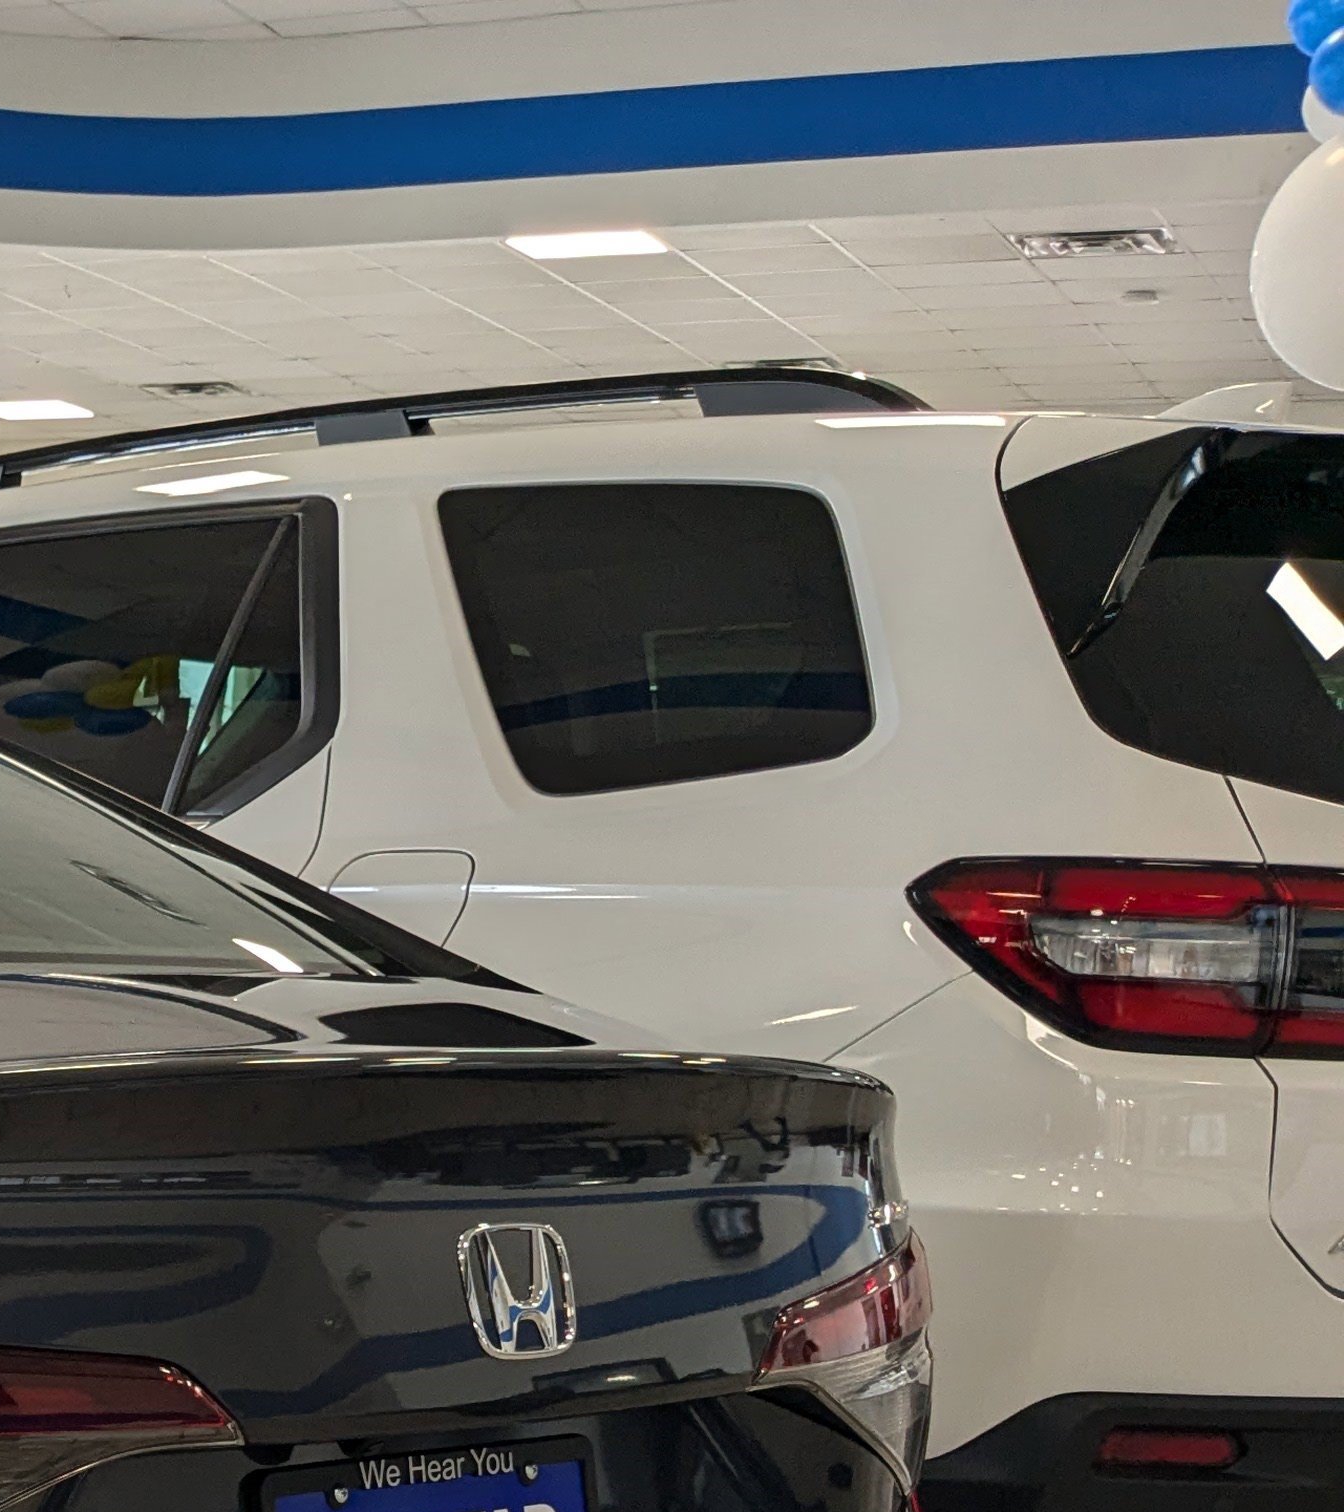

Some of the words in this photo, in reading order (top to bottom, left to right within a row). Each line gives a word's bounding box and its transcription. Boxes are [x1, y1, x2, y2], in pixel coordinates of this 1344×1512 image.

[359, 1459, 401, 1490] We
[408, 1455, 465, 1485] Hear
[470, 1447, 514, 1477] You
